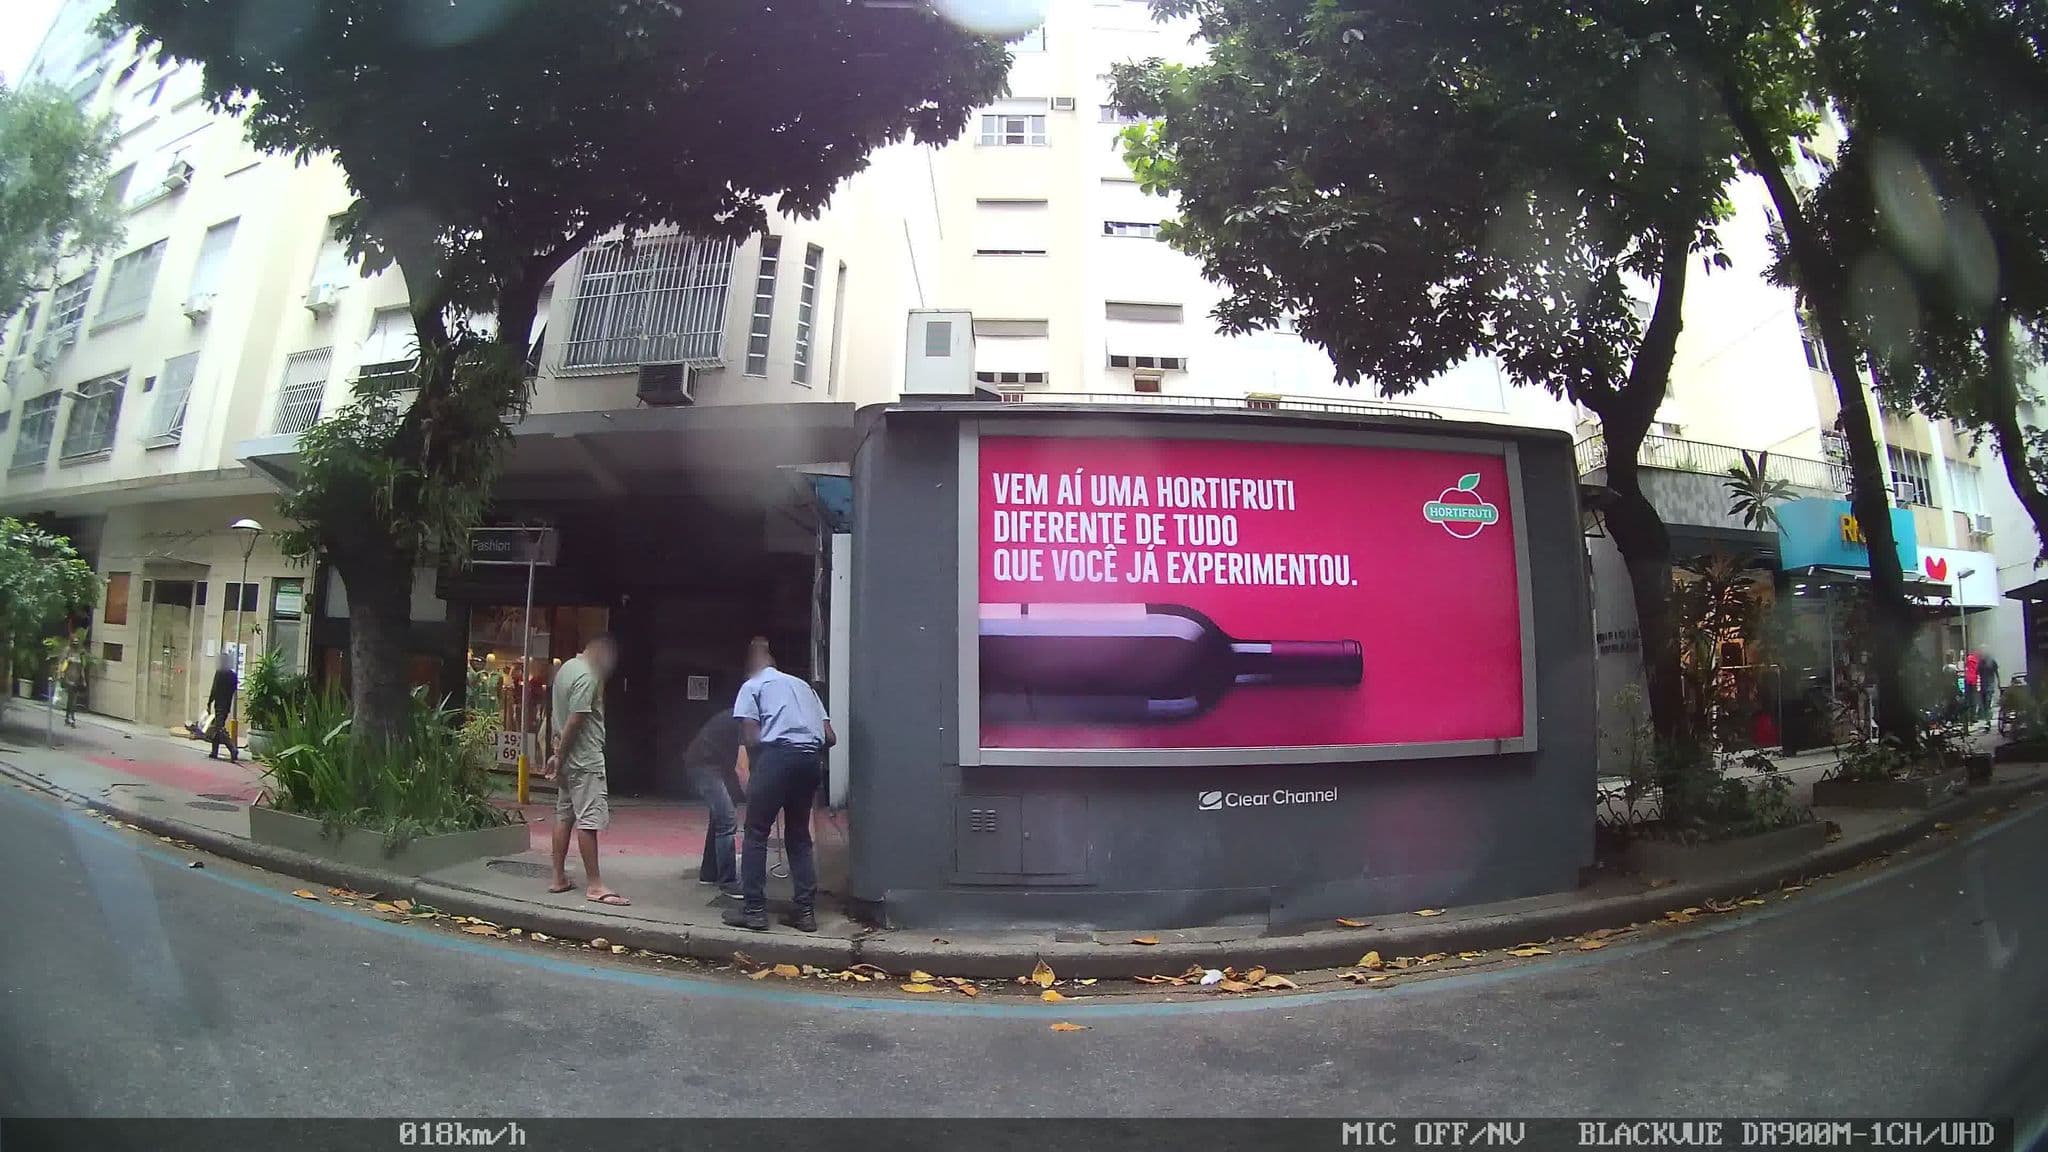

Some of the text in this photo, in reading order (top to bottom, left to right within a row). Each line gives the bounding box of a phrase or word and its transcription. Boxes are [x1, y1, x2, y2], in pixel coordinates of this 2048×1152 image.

[993, 468, 1295, 511] VEM AÍ UMA HORTIFRUTI
[1429, 507, 1492, 519] HORTIFRUTI
[994, 511, 1238, 547] DIFERENTE DE TUDO
[471, 539, 511, 552] Fashion
[994, 544, 1358, 586] QUE VOCÊ JÁ EXPERIMENTOU.
[1226, 787, 1338, 807] Clear Channel
